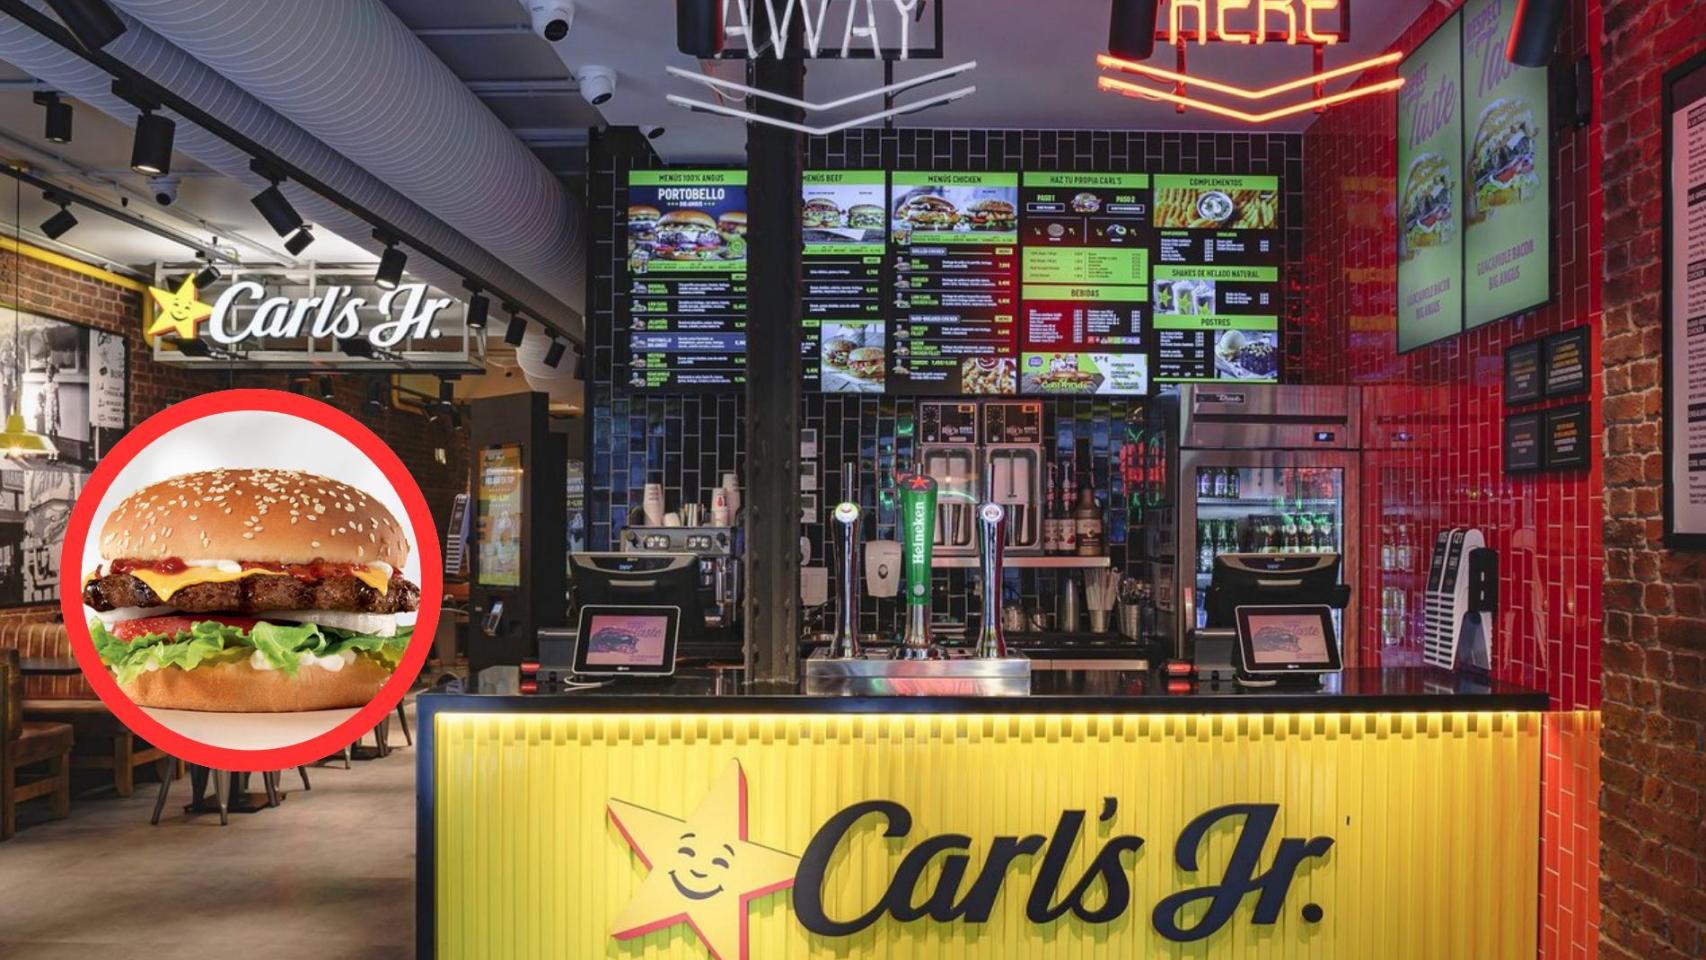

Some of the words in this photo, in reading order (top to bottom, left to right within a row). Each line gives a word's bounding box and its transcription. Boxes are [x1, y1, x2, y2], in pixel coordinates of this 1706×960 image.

[953, 175, 982, 184] CHICKEN
[1189, 178, 1243, 187] COMPLEMENTOS
[658, 188, 725, 200] PORTOBELLO
[1231, 270, 1259, 278] NATURAL
[1071, 288, 1100, 298] BEBIDAS
[208, 281, 367, 344] Carl's
[368, 283, 452, 348] Jr.
[1202, 318, 1231, 326] POSTRES
[912, 500, 925, 565] Heineken
[791, 796, 1145, 938] Carl's
[1152, 802, 1336, 942] Jr.
